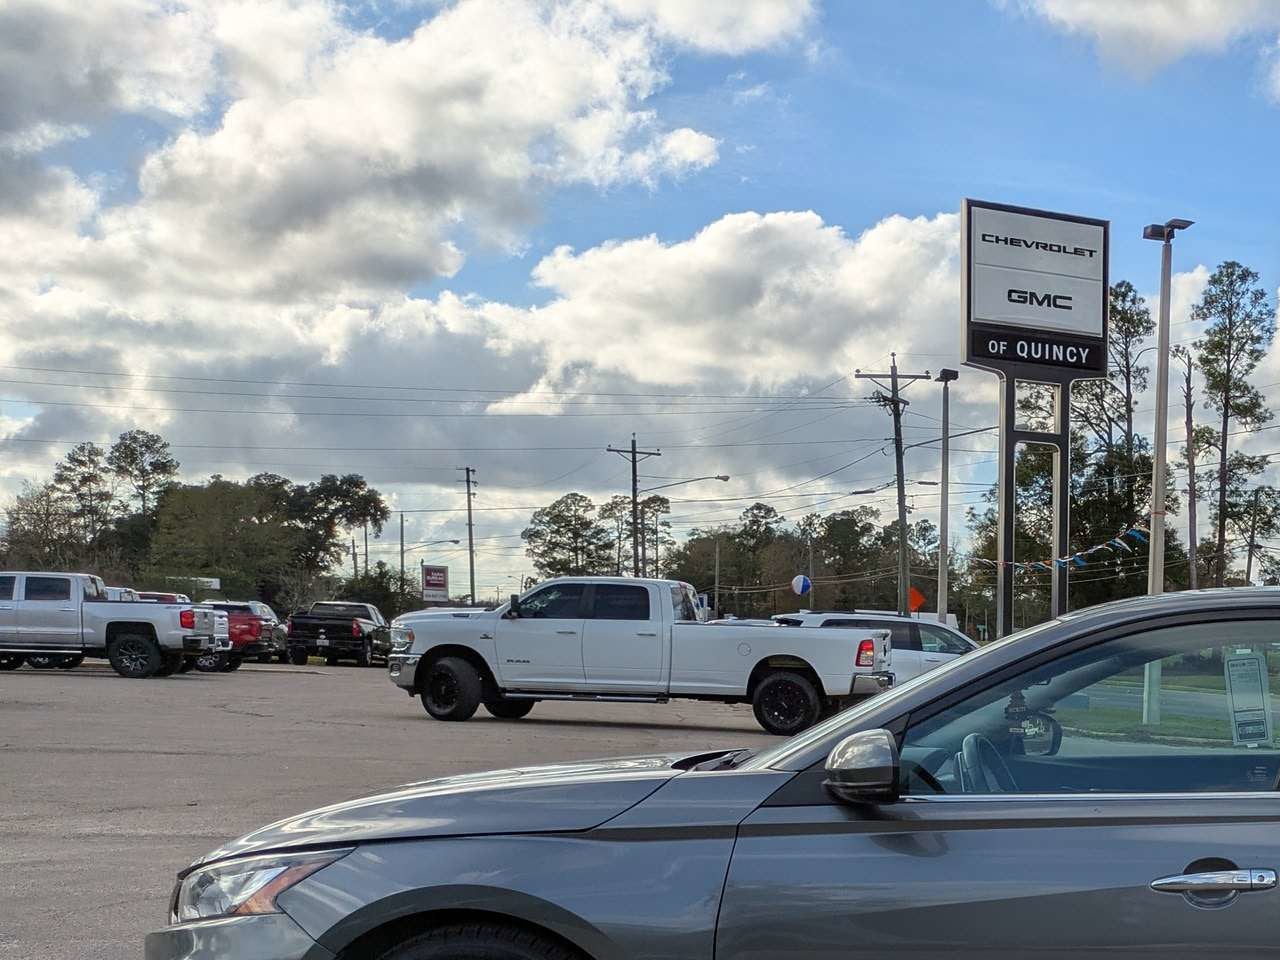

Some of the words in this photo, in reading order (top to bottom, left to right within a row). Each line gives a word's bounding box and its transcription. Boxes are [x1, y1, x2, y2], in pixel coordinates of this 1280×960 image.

[981, 233, 1097, 258] CHEVROLET
[1007, 288, 1073, 311] GMC
[988, 340, 1008, 355] OF
[1016, 340, 1090, 364] QUINCY
